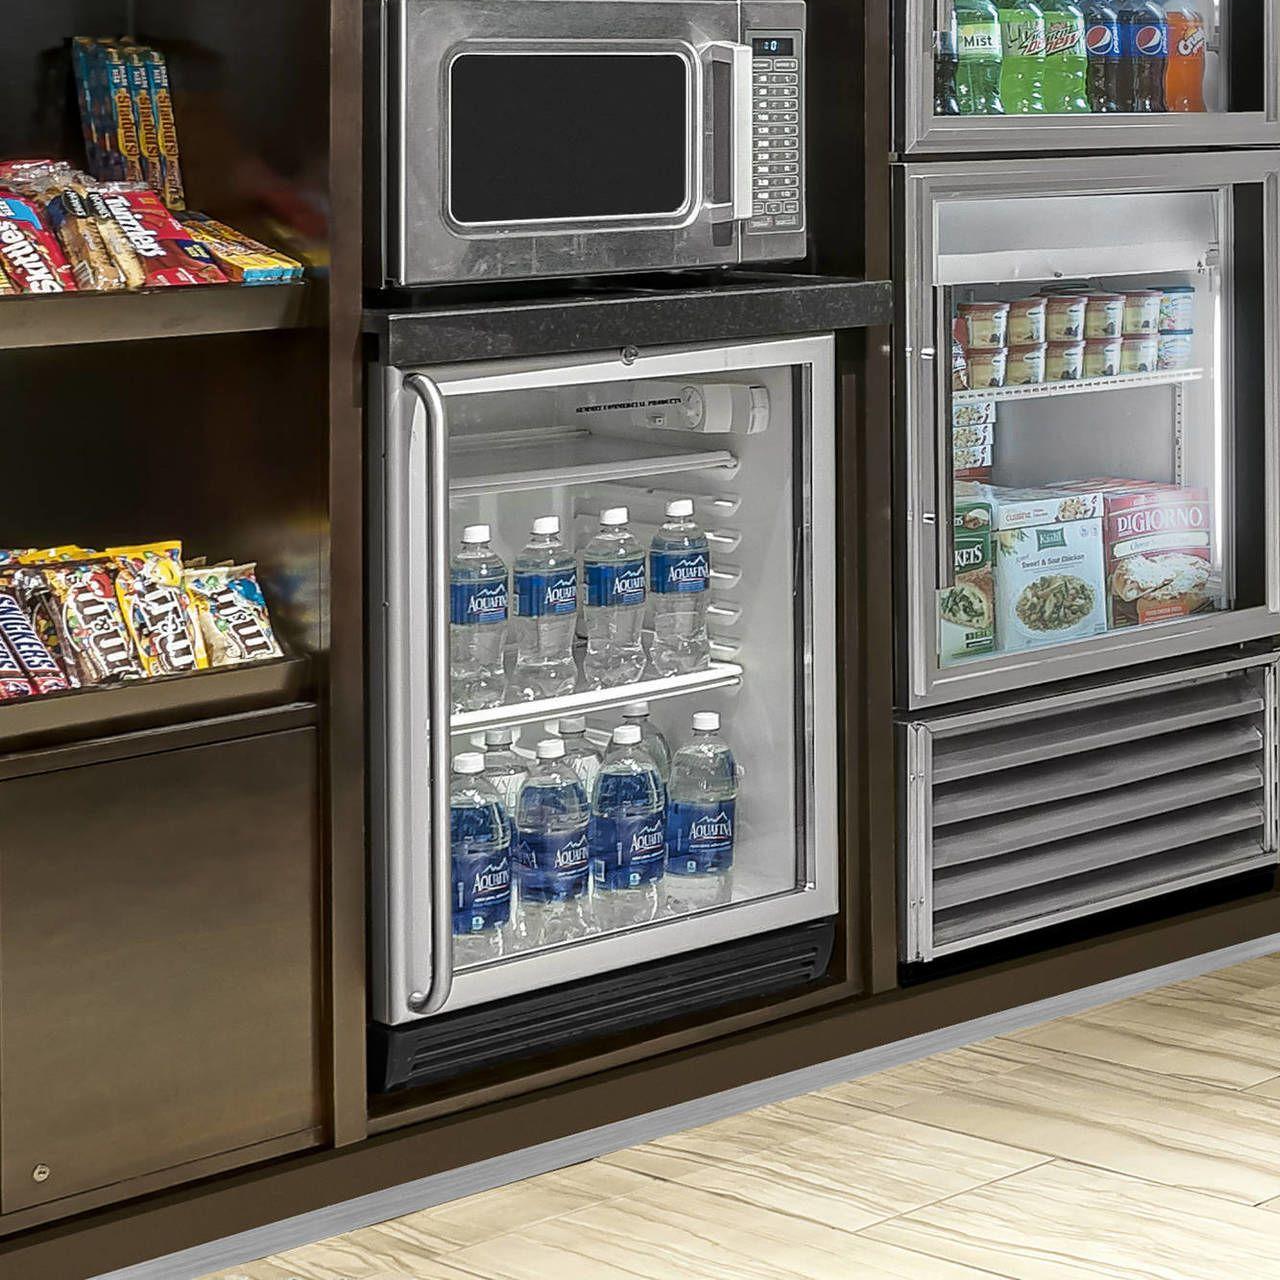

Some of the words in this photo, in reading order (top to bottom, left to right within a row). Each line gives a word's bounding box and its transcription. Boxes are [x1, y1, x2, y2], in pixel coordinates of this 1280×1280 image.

[964, 34, 993, 48] Mist
[1112, 25, 1120, 54] pepsi
[1021, 560, 1041, 569] Sweet
[1048, 557, 1061, 565] Sour
[1061, 554, 1085, 563] Chicken
[0, 592, 57, 670] SNICKERS
